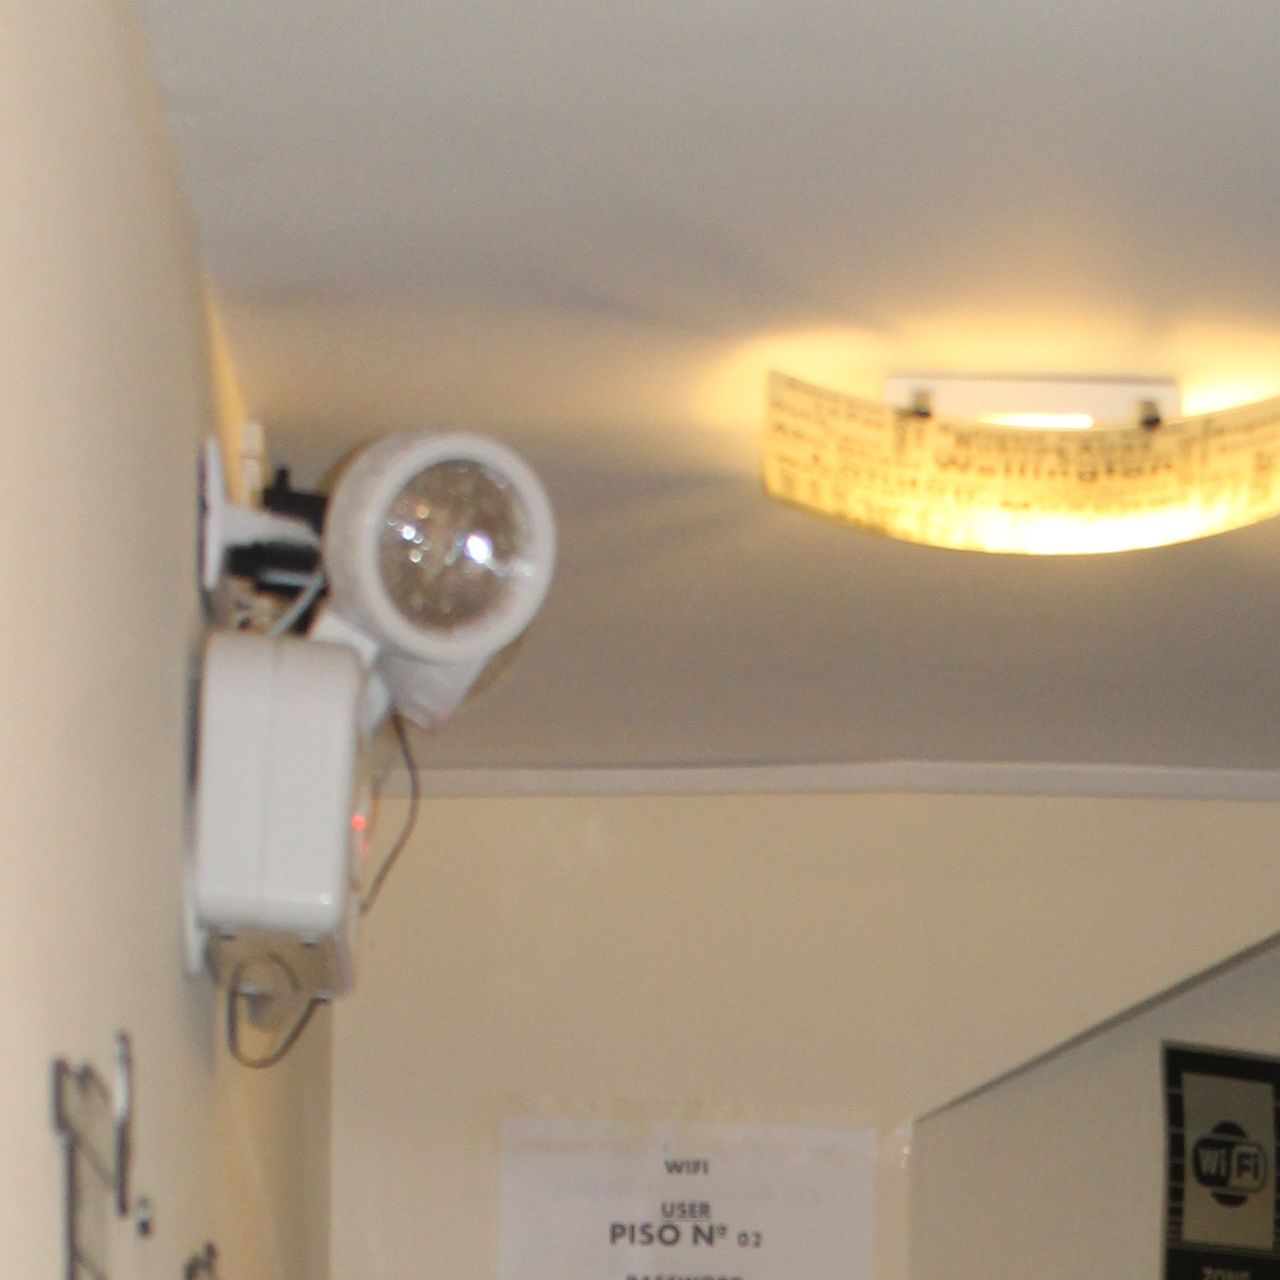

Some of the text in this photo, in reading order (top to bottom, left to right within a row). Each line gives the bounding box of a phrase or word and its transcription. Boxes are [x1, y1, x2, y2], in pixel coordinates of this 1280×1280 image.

[664, 1160, 709, 1176] WIFI
[661, 1202, 711, 1219] USER
[609, 1223, 680, 1246] PISO
[737, 1231, 762, 1248] 02
